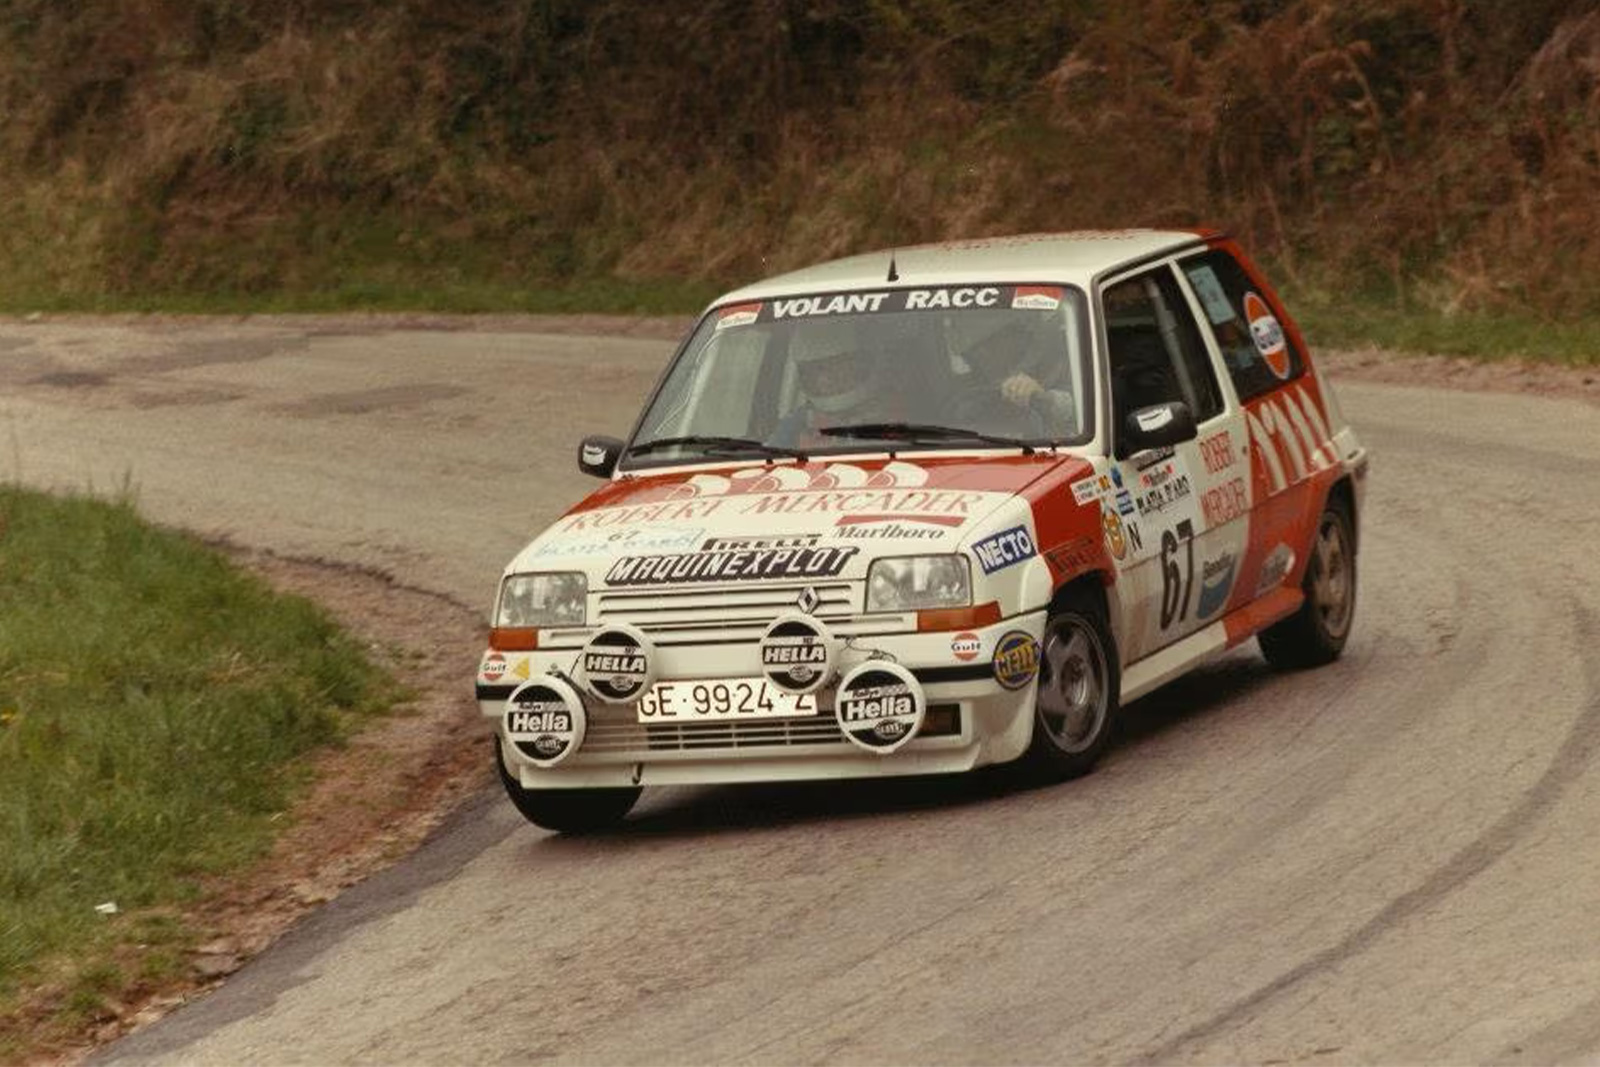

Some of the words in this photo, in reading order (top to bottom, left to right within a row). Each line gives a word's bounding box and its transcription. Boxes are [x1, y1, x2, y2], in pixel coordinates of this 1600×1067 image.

[772, 294, 889, 318] VOLANT
[905, 287, 999, 309] RACC
[562, 499, 723, 533] ROBERT
[741, 492, 983, 515] MERCADER
[833, 524, 945, 540] Marlboro
[1127, 521, 1143, 551] N
[977, 529, 1032, 569] NECTO
[605, 547, 856, 582] MAQUINEXPLOT
[1160, 518, 1194, 630] 67
[586, 655, 646, 672] HELLA
[764, 646, 826, 663] HELLA
[512, 711, 569, 732] Hella
[846, 696, 911, 721] Hella
